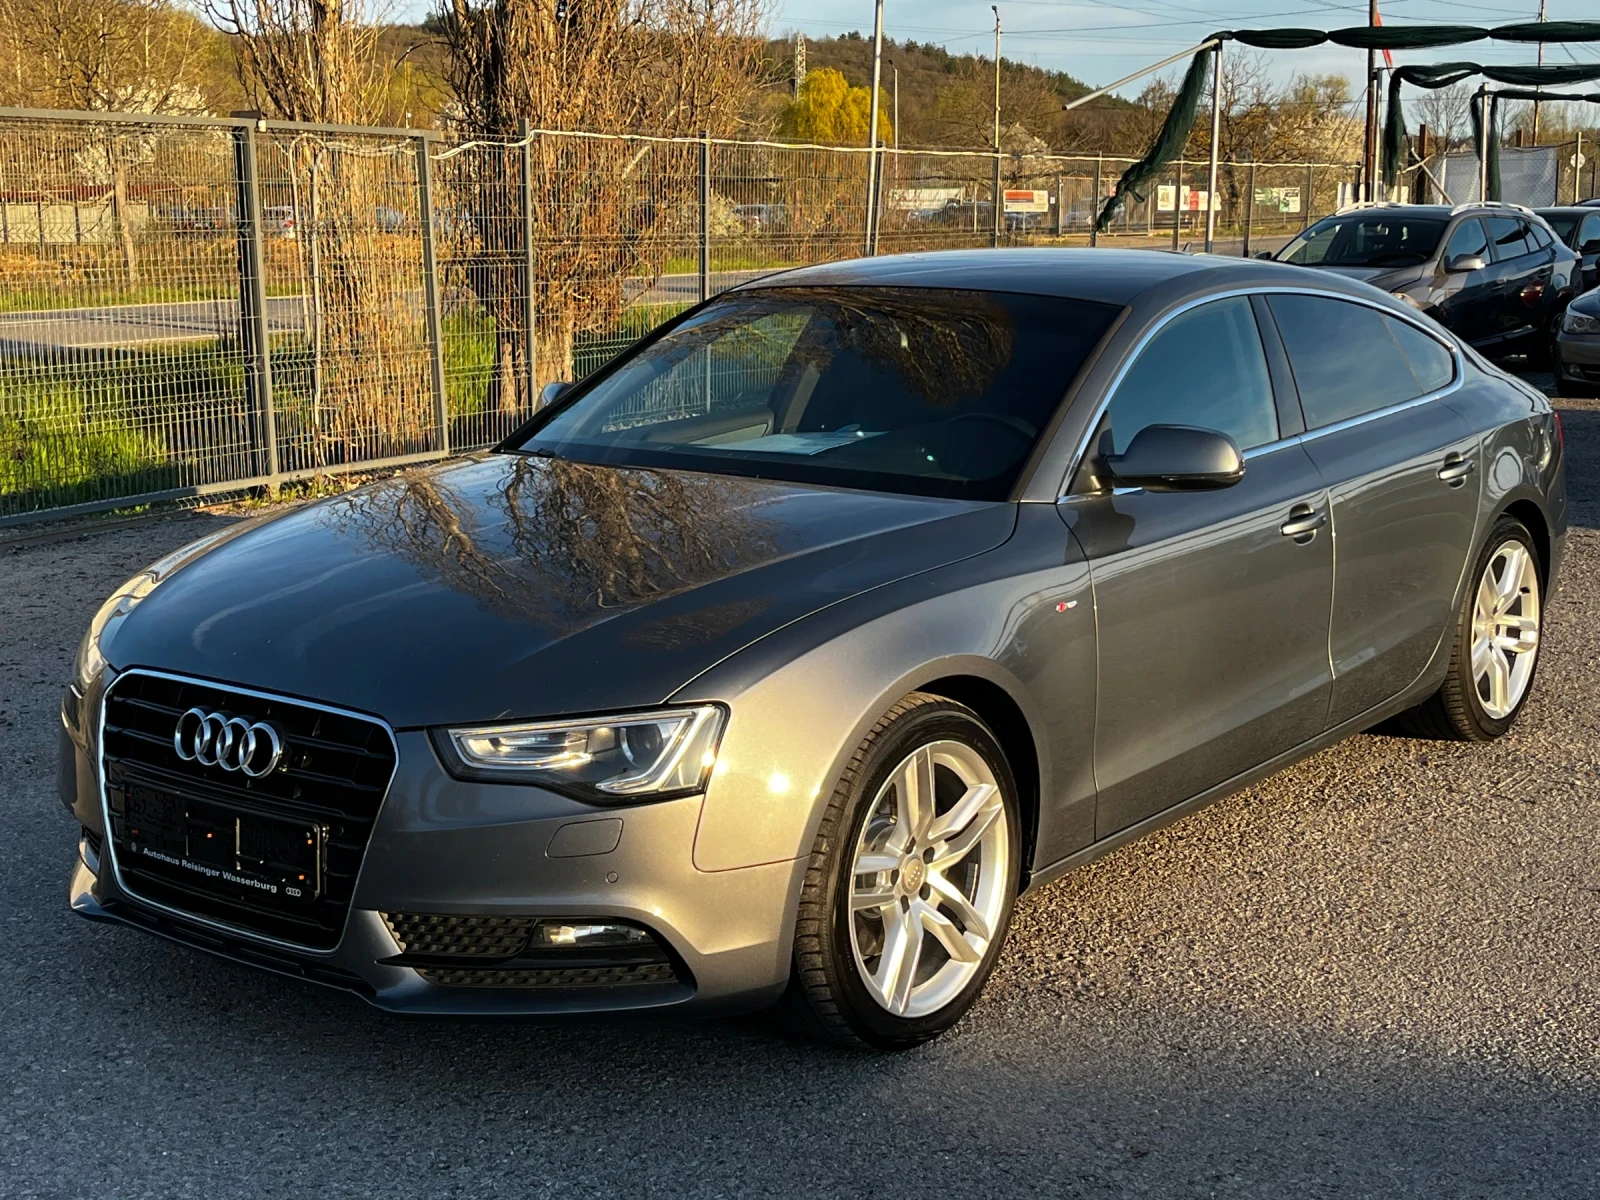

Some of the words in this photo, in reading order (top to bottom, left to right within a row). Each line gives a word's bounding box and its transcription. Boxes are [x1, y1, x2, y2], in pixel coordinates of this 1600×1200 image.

[143, 847, 180, 866] Autohaus
[181, 859, 220, 877] Reisinger
[222, 871, 278, 894] Wasserburg
